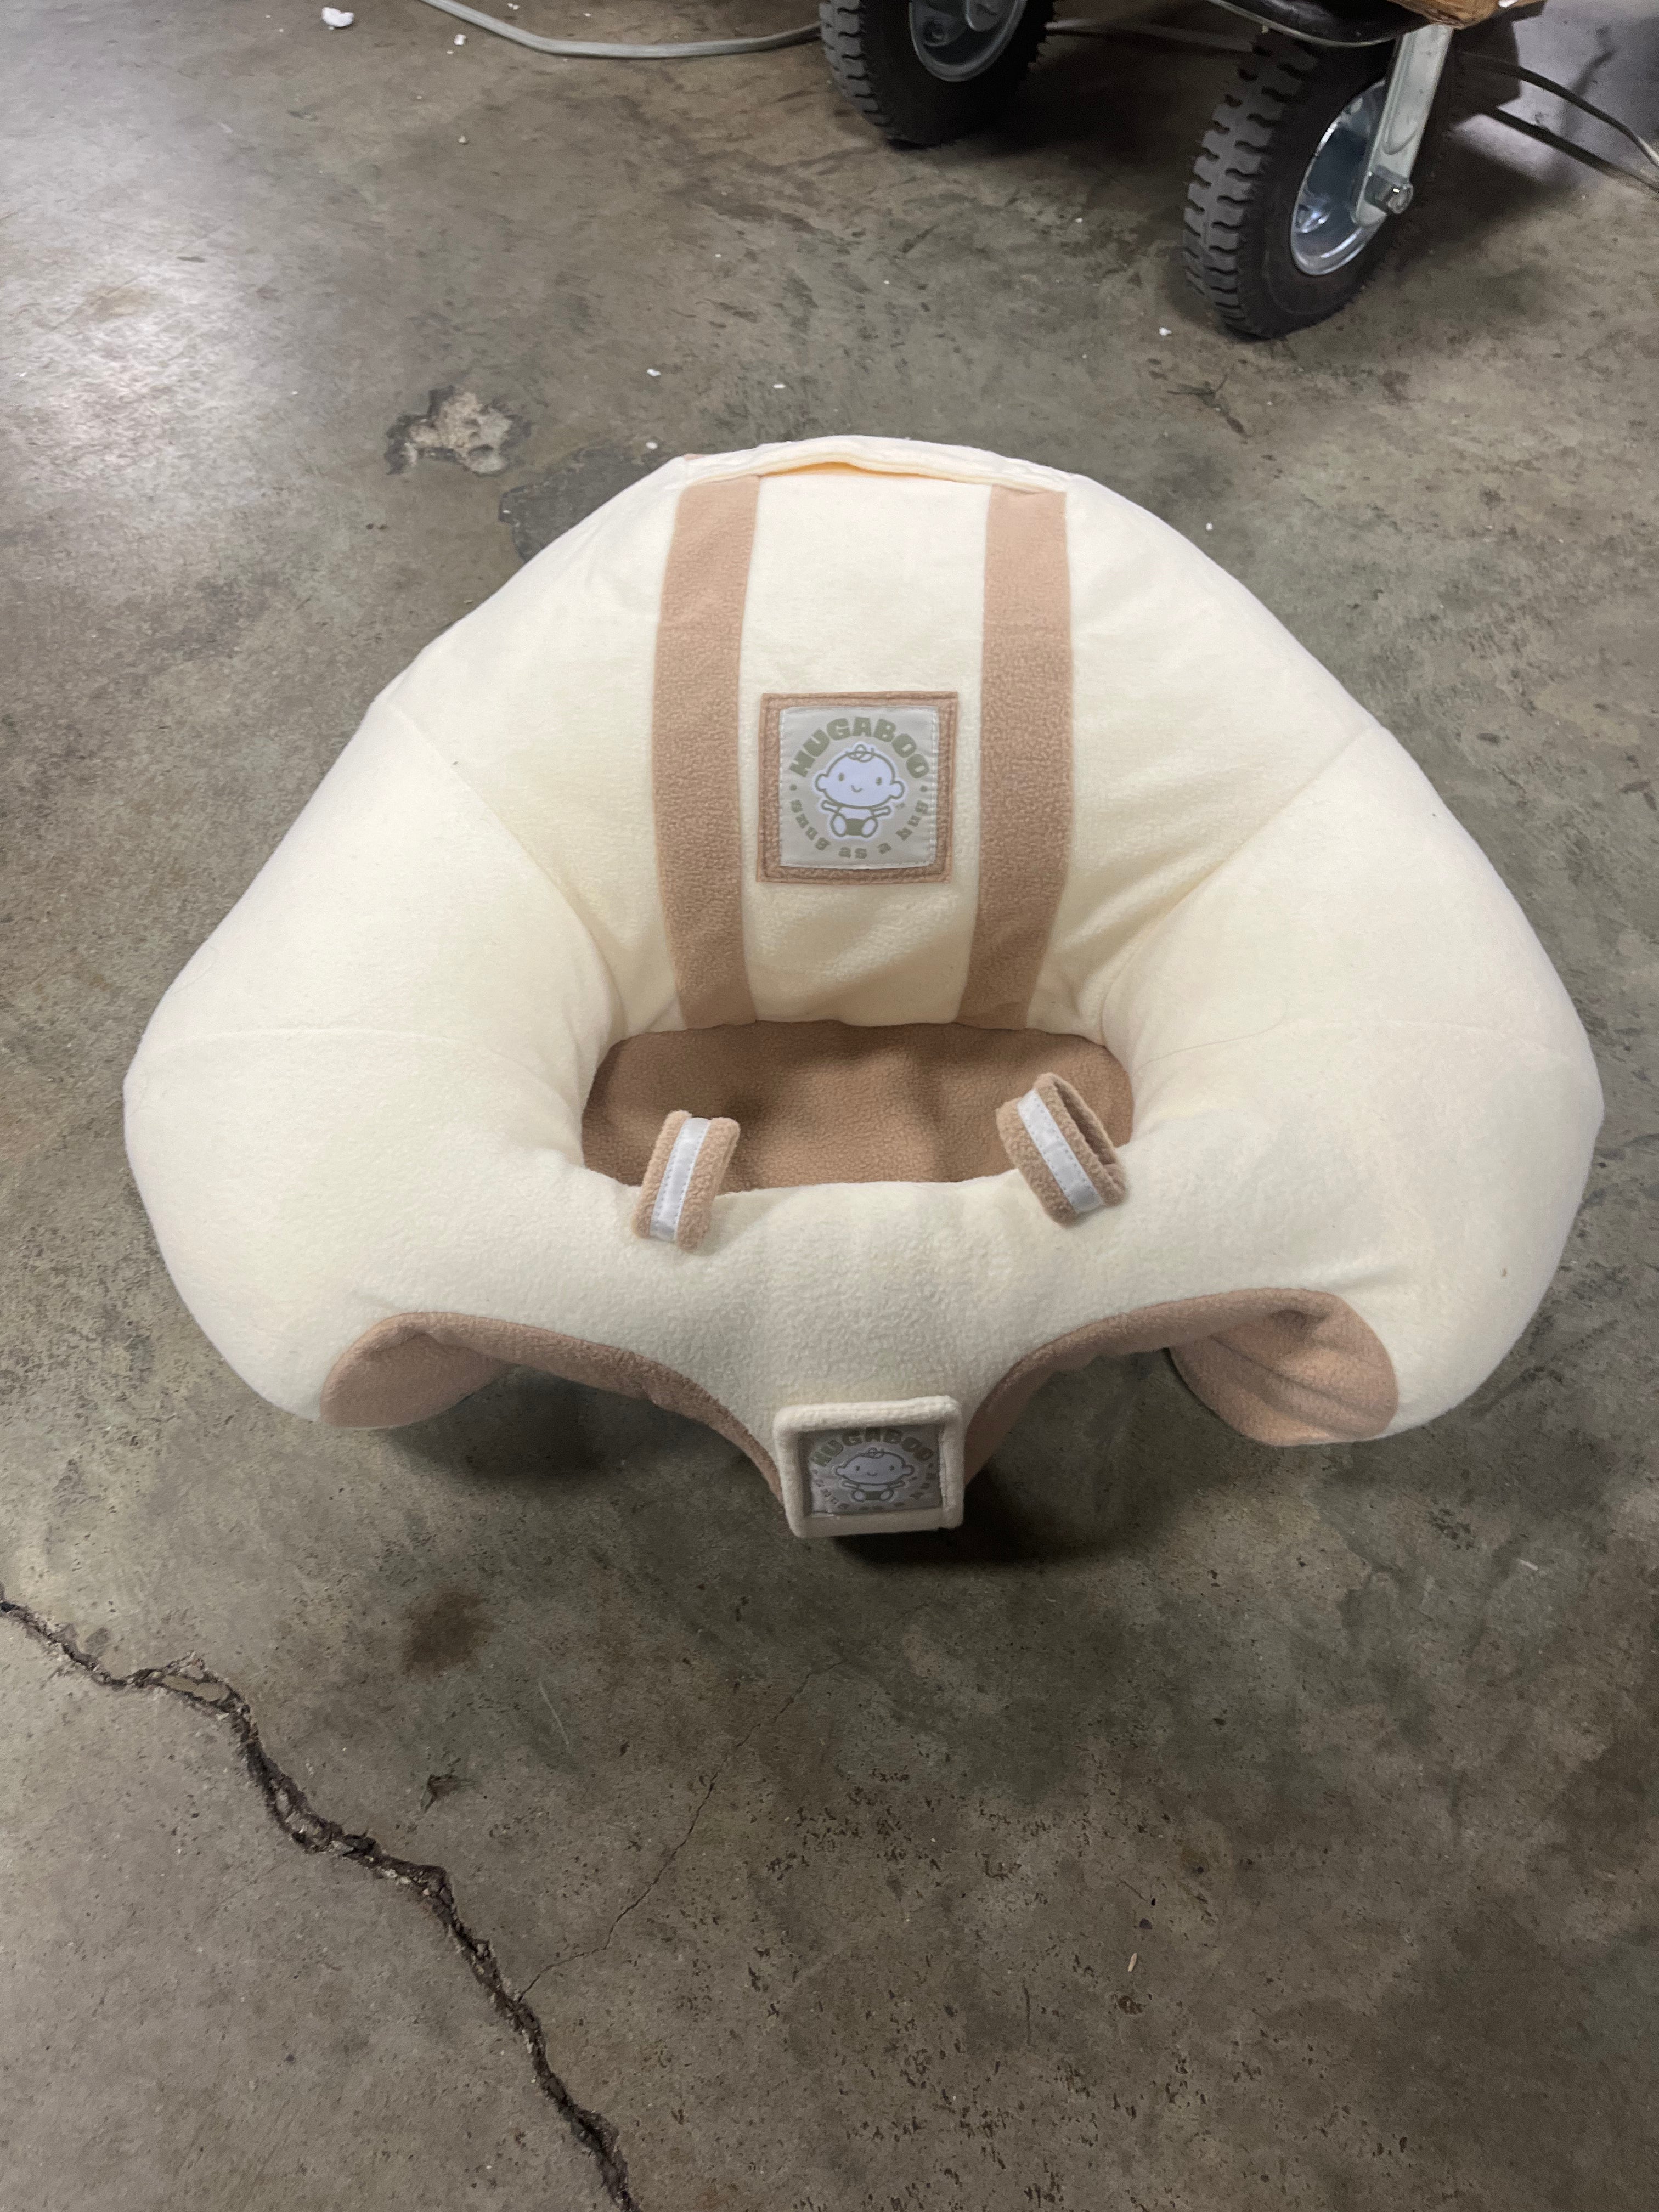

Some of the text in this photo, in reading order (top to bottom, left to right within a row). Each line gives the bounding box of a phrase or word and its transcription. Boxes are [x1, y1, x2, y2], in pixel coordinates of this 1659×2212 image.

[789, 716, 930, 779] HUGABOO
[838, 847, 867, 859] as
[878, 842, 892, 854] a
[810, 1427, 935, 1467] HUGABOO
